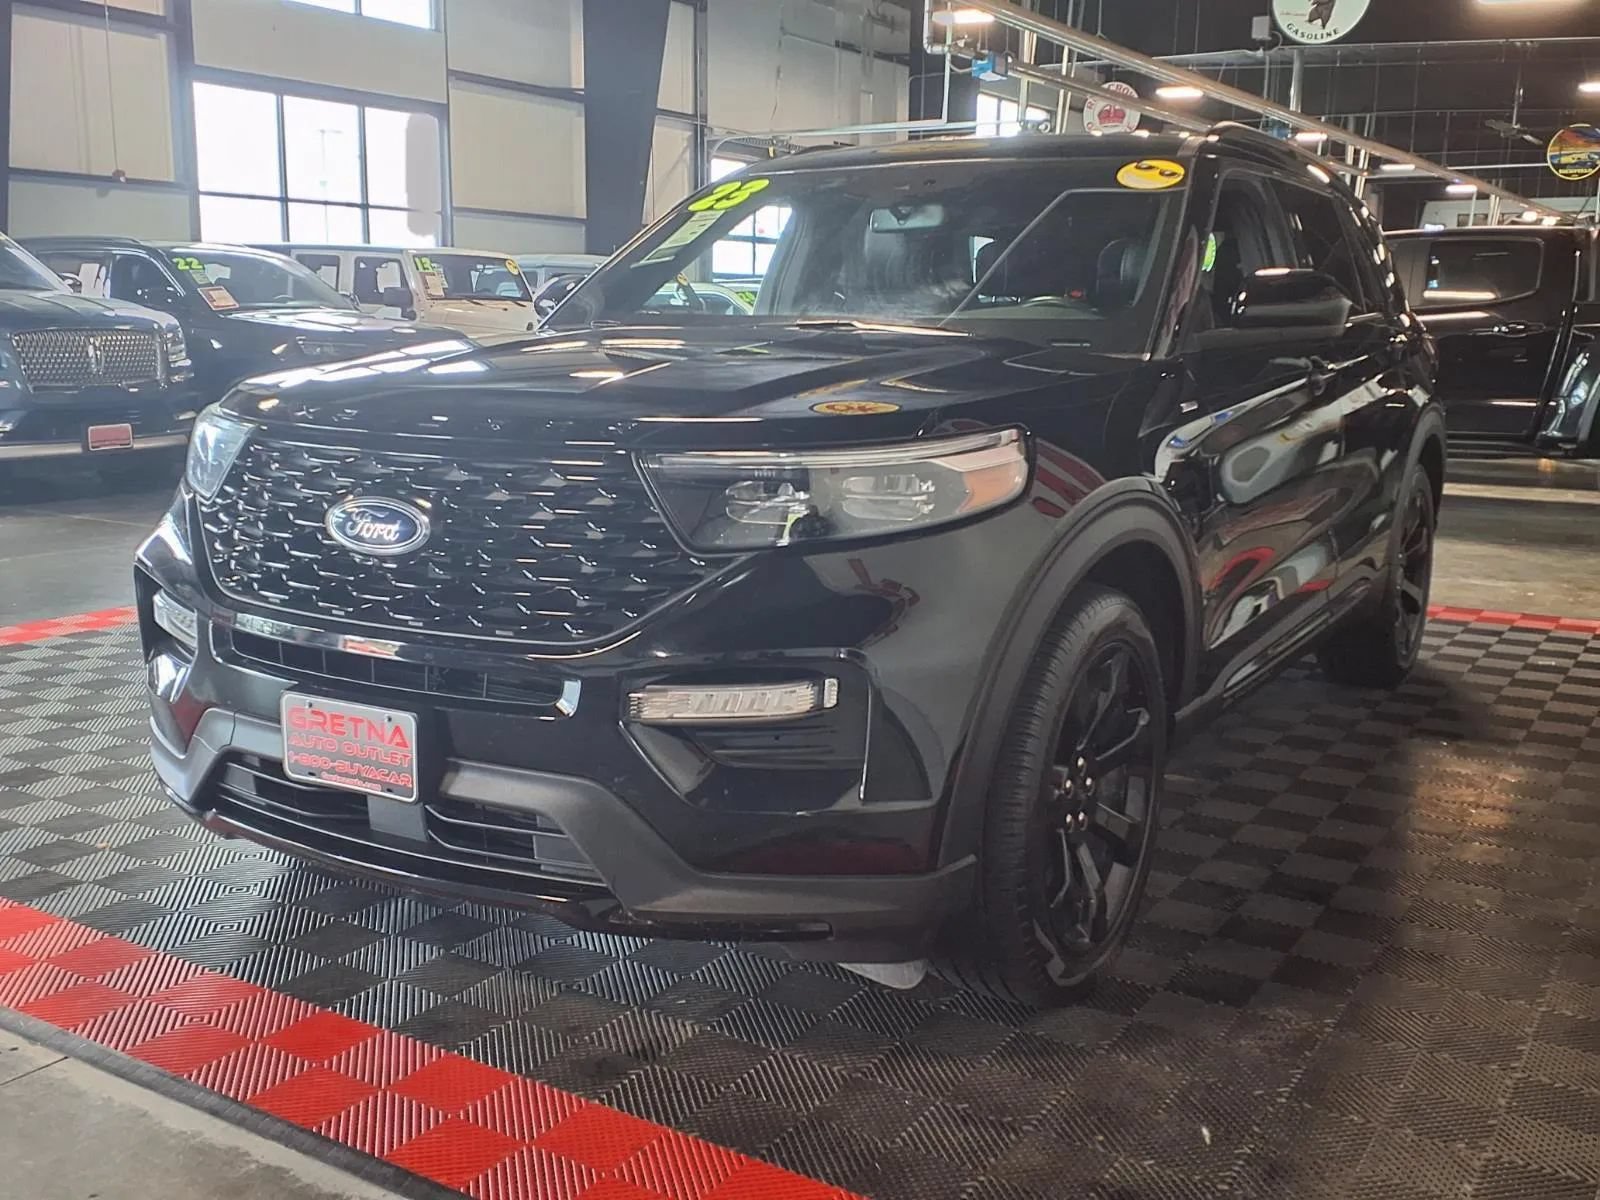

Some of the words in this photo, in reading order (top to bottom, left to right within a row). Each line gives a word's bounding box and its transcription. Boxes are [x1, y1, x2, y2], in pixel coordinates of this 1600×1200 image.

[1286, 22, 1341, 40] GASOLINE
[687, 178, 770, 212] 23
[172, 256, 204, 271] 22
[345, 507, 401, 541] Ford
[287, 705, 410, 749] GRETNA
[288, 733, 338, 753] AUTO
[342, 741, 412, 767] OUTLET
